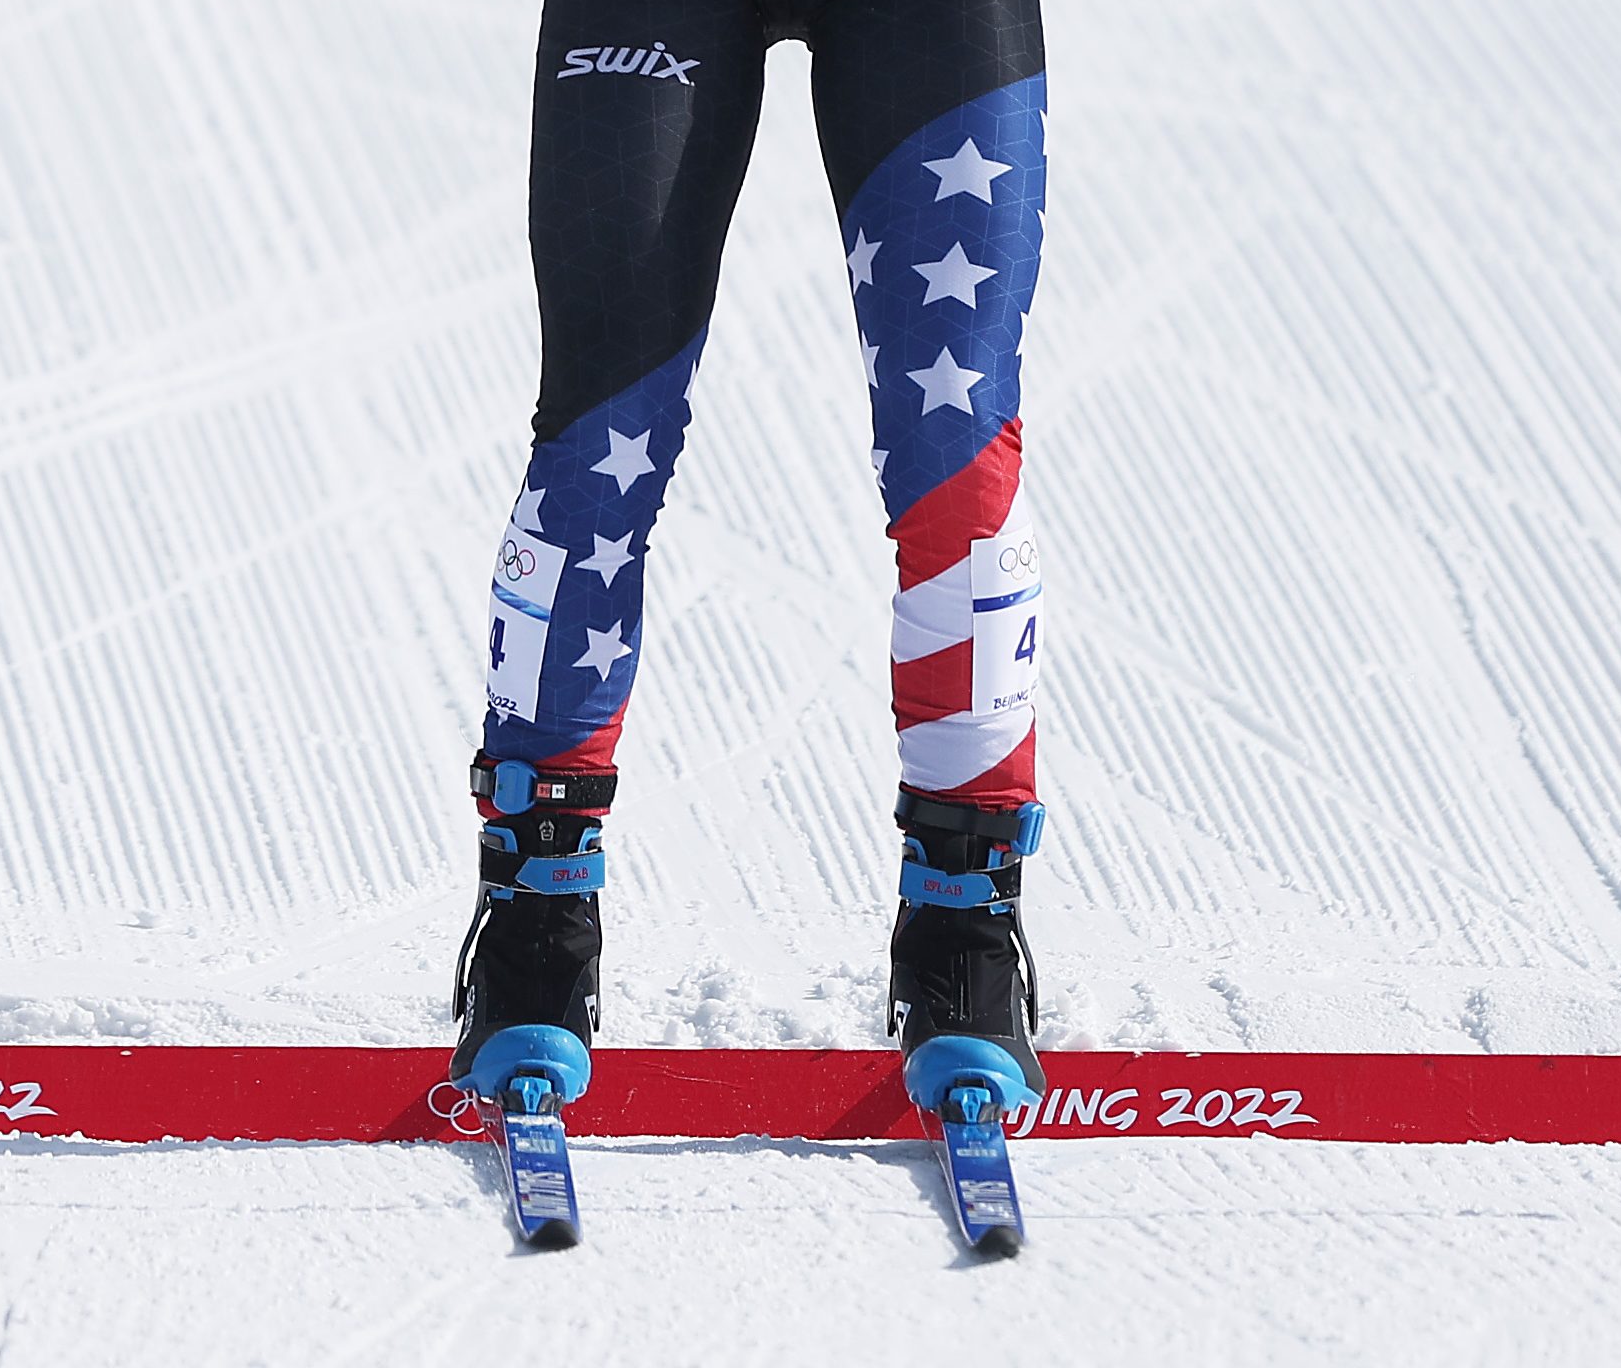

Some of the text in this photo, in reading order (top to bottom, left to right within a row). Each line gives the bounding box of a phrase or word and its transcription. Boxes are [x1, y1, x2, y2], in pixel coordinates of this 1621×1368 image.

[1015, 615, 1037, 665] 4
[993, 689, 1029, 710] BEIJING
[1000, 1088, 1319, 1137] JING 2022
